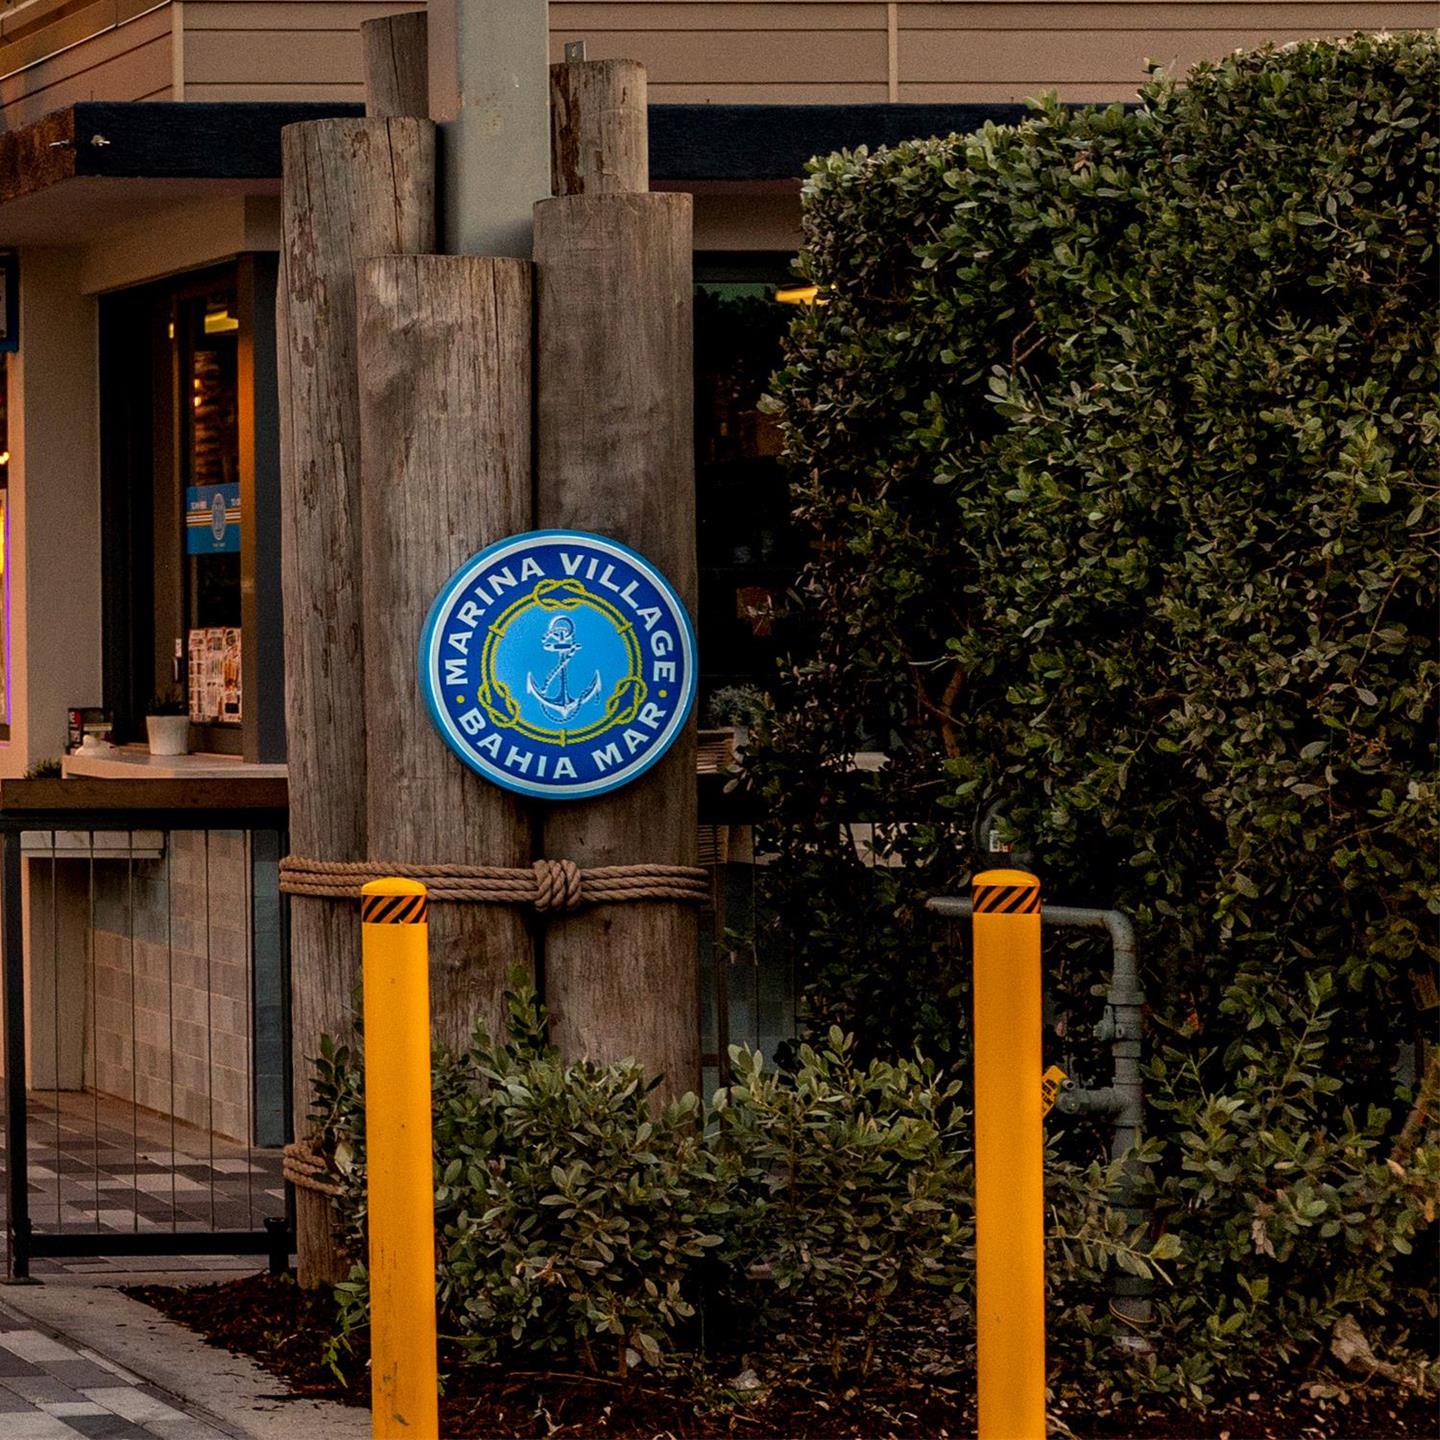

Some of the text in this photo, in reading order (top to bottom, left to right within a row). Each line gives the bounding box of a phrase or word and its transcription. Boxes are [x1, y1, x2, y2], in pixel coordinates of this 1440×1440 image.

[444, 553, 676, 686] MARINA VILLAGE
[458, 701, 666, 779] BAHIA MAR
